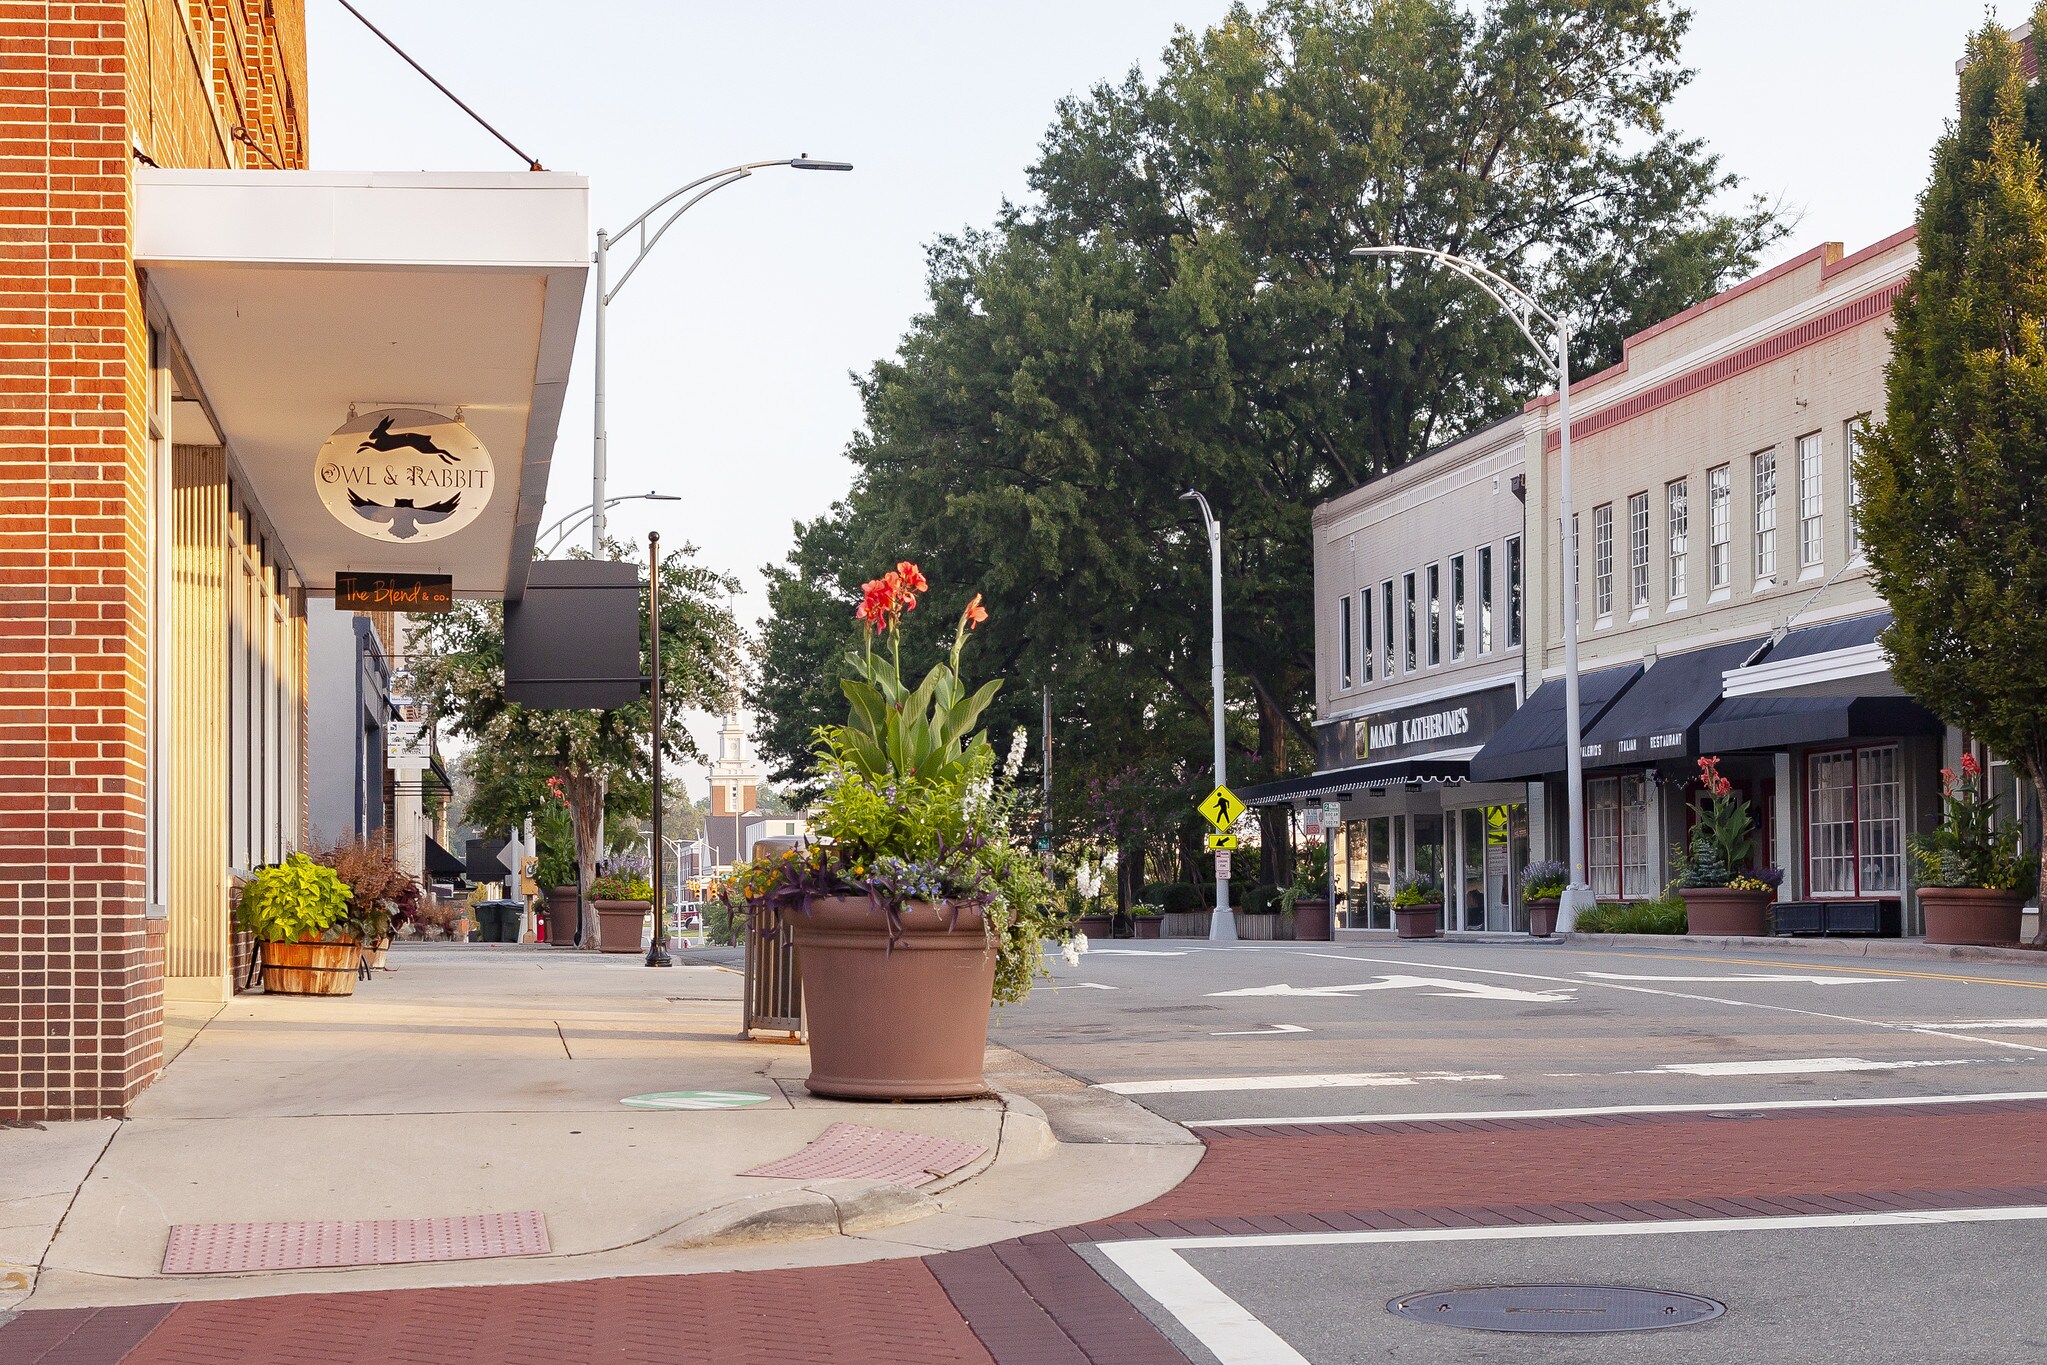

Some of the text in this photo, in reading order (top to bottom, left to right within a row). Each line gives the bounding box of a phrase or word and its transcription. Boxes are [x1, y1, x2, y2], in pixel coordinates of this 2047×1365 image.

[320, 462, 489, 489] OWL & RABBIT
[338, 577, 449, 605] The Blend & co.
[1370, 707, 1469, 750] MARY KATHERINE'S
[1618, 739, 1637, 752] ITALIAN
[1649, 733, 1682, 748] RESTAURANT
[1324, 803, 1329, 811] 2
